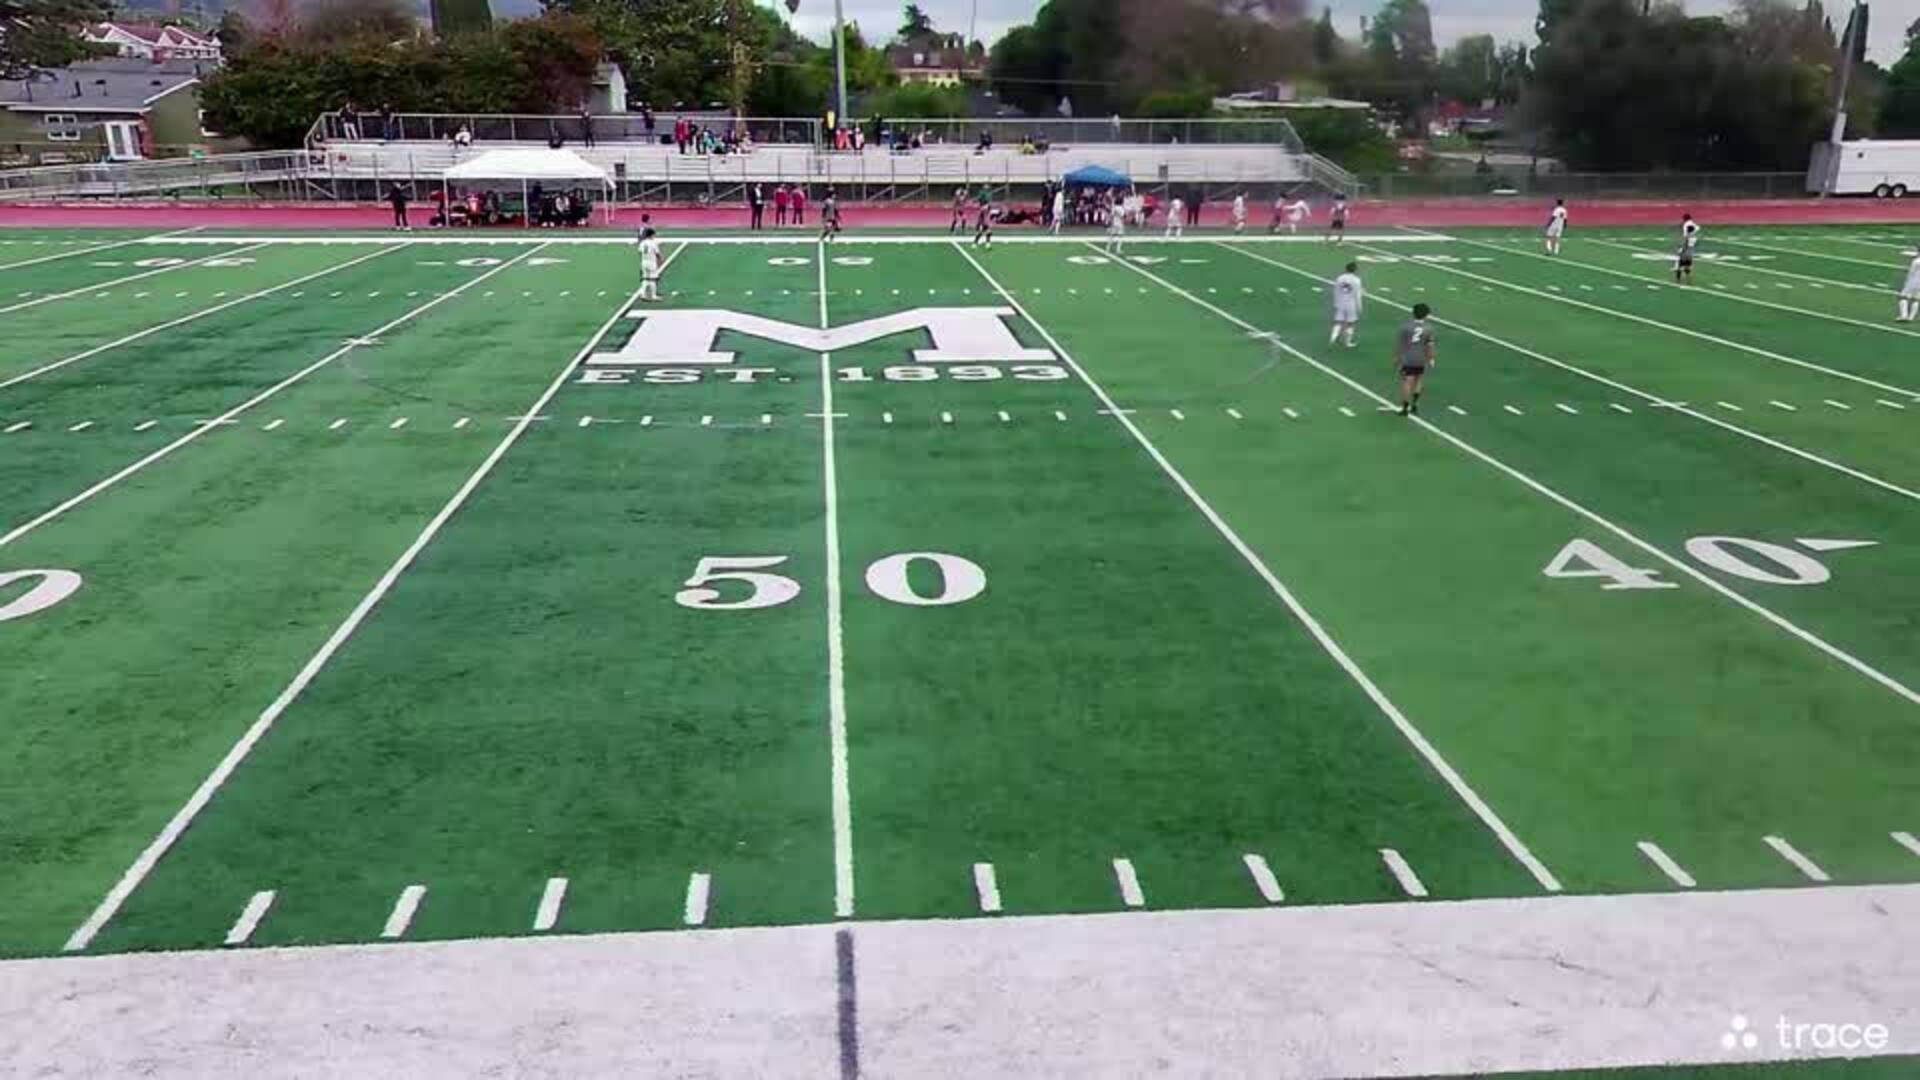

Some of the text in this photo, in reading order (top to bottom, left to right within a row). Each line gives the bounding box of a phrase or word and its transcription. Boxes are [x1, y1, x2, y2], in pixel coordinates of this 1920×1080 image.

[584, 307, 1057, 364] M
[574, 366, 1070, 384] EST. 1893
[675, 552, 987, 609] 50
